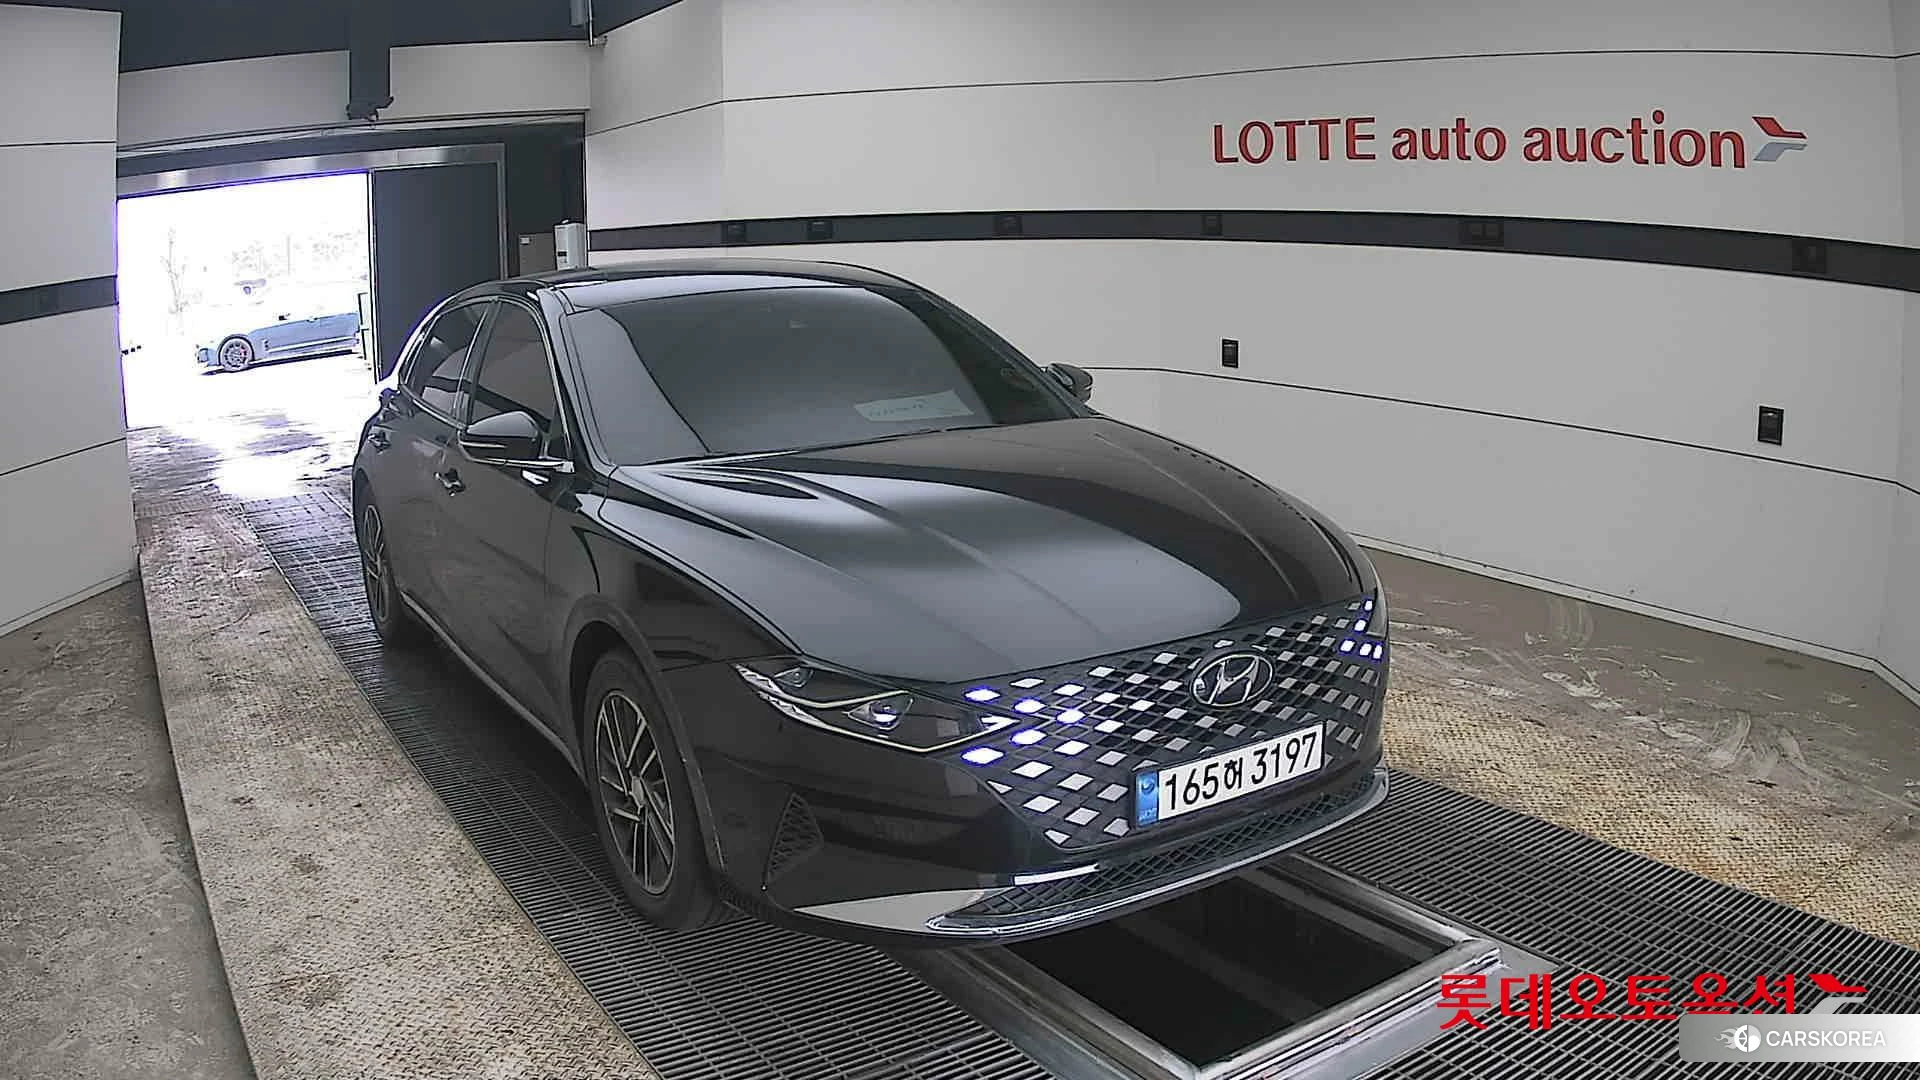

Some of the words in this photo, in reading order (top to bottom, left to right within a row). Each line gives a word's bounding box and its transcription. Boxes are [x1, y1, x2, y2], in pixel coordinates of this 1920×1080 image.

[1213, 116, 1376, 164] LOTTE
[1392, 117, 1507, 161] auto
[1523, 109, 1746, 169] auction
[1165, 757, 1243, 811] 165허
[1251, 732, 1317, 785] 3197
